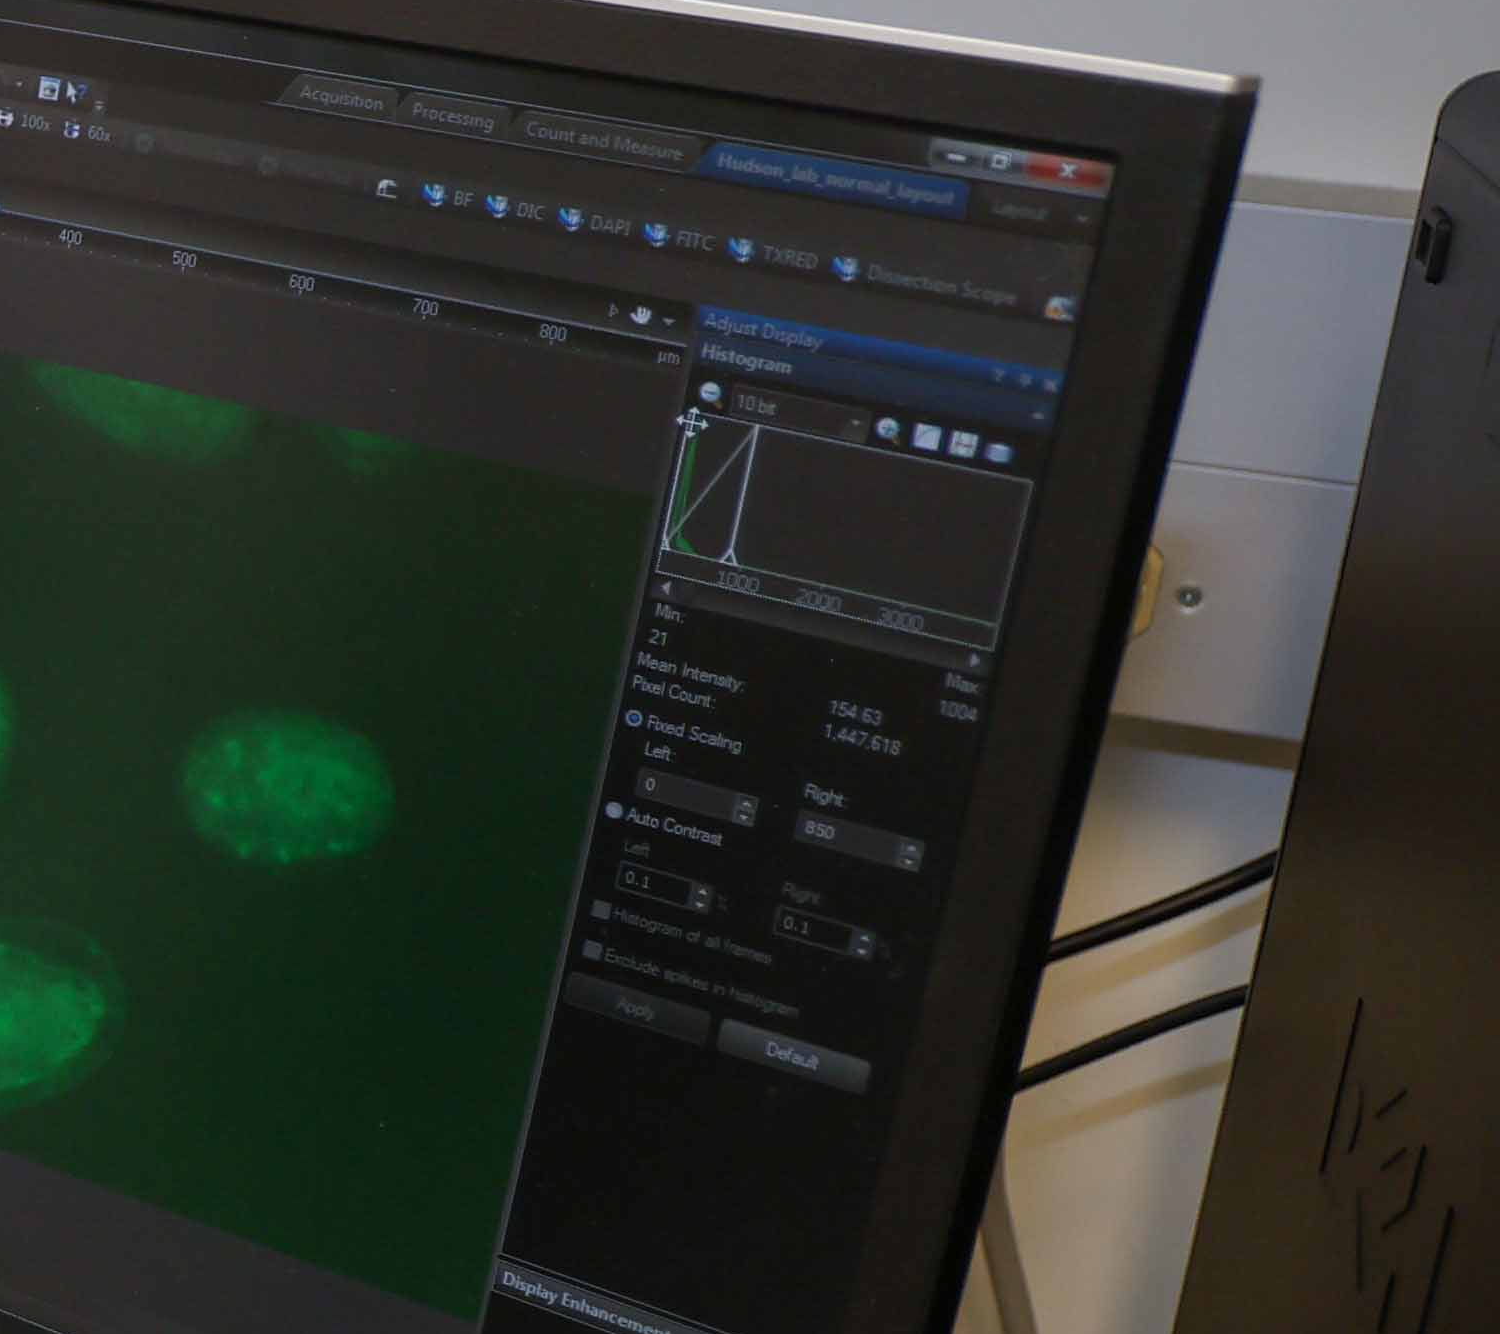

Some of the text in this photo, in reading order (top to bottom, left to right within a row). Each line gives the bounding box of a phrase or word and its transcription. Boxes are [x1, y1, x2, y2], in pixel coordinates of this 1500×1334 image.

[300, 83, 956, 206] Acquisition Processing Count and Measure Hudson_lab_normal_layout
[453, 189, 1018, 307] BF DIC DAPI FITC TXRED Dissection Scope
[172, 250, 568, 343] 500 600 700 800
[703, 312, 825, 355] Adjust Display
[701, 342, 793, 376] Histogram
[648, 629, 669, 646] 21
[632, 674, 716, 710] Pixel Count:
[636, 651, 746, 694] Mean Intensity:
[939, 699, 979, 723] 1004
[646, 715, 744, 756] Fixed Scaling
[625, 807, 725, 848] Auto Contrast
[803, 819, 836, 841] 850
[764, 1041, 820, 1071] Default
[502, 1270, 560, 1307] Display
